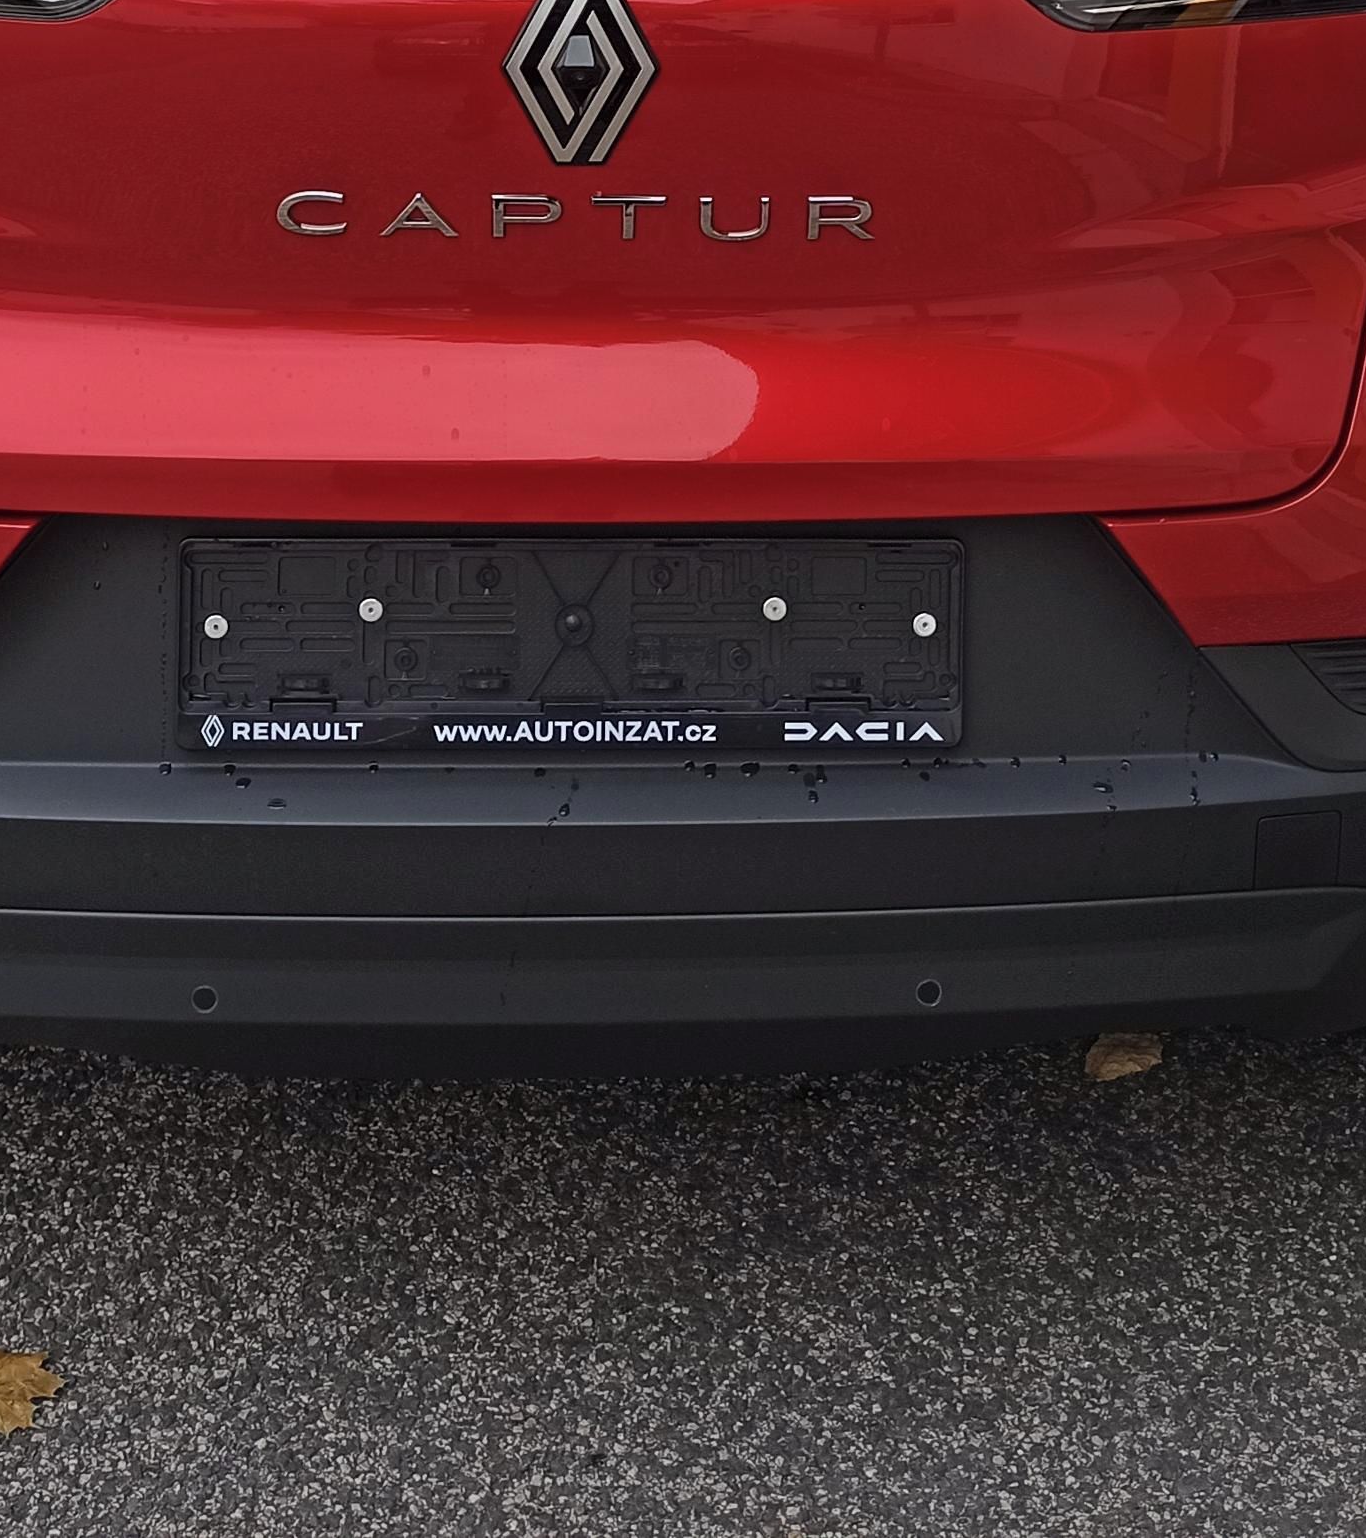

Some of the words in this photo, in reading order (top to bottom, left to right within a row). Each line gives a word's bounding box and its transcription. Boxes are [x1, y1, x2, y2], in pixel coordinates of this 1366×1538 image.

[276, 190, 875, 241] CAPTUR
[232, 722, 364, 741] RENAULT
[433, 720, 717, 742] www.AUTOINZAT.cz
[784, 721, 945, 741] DACIA
